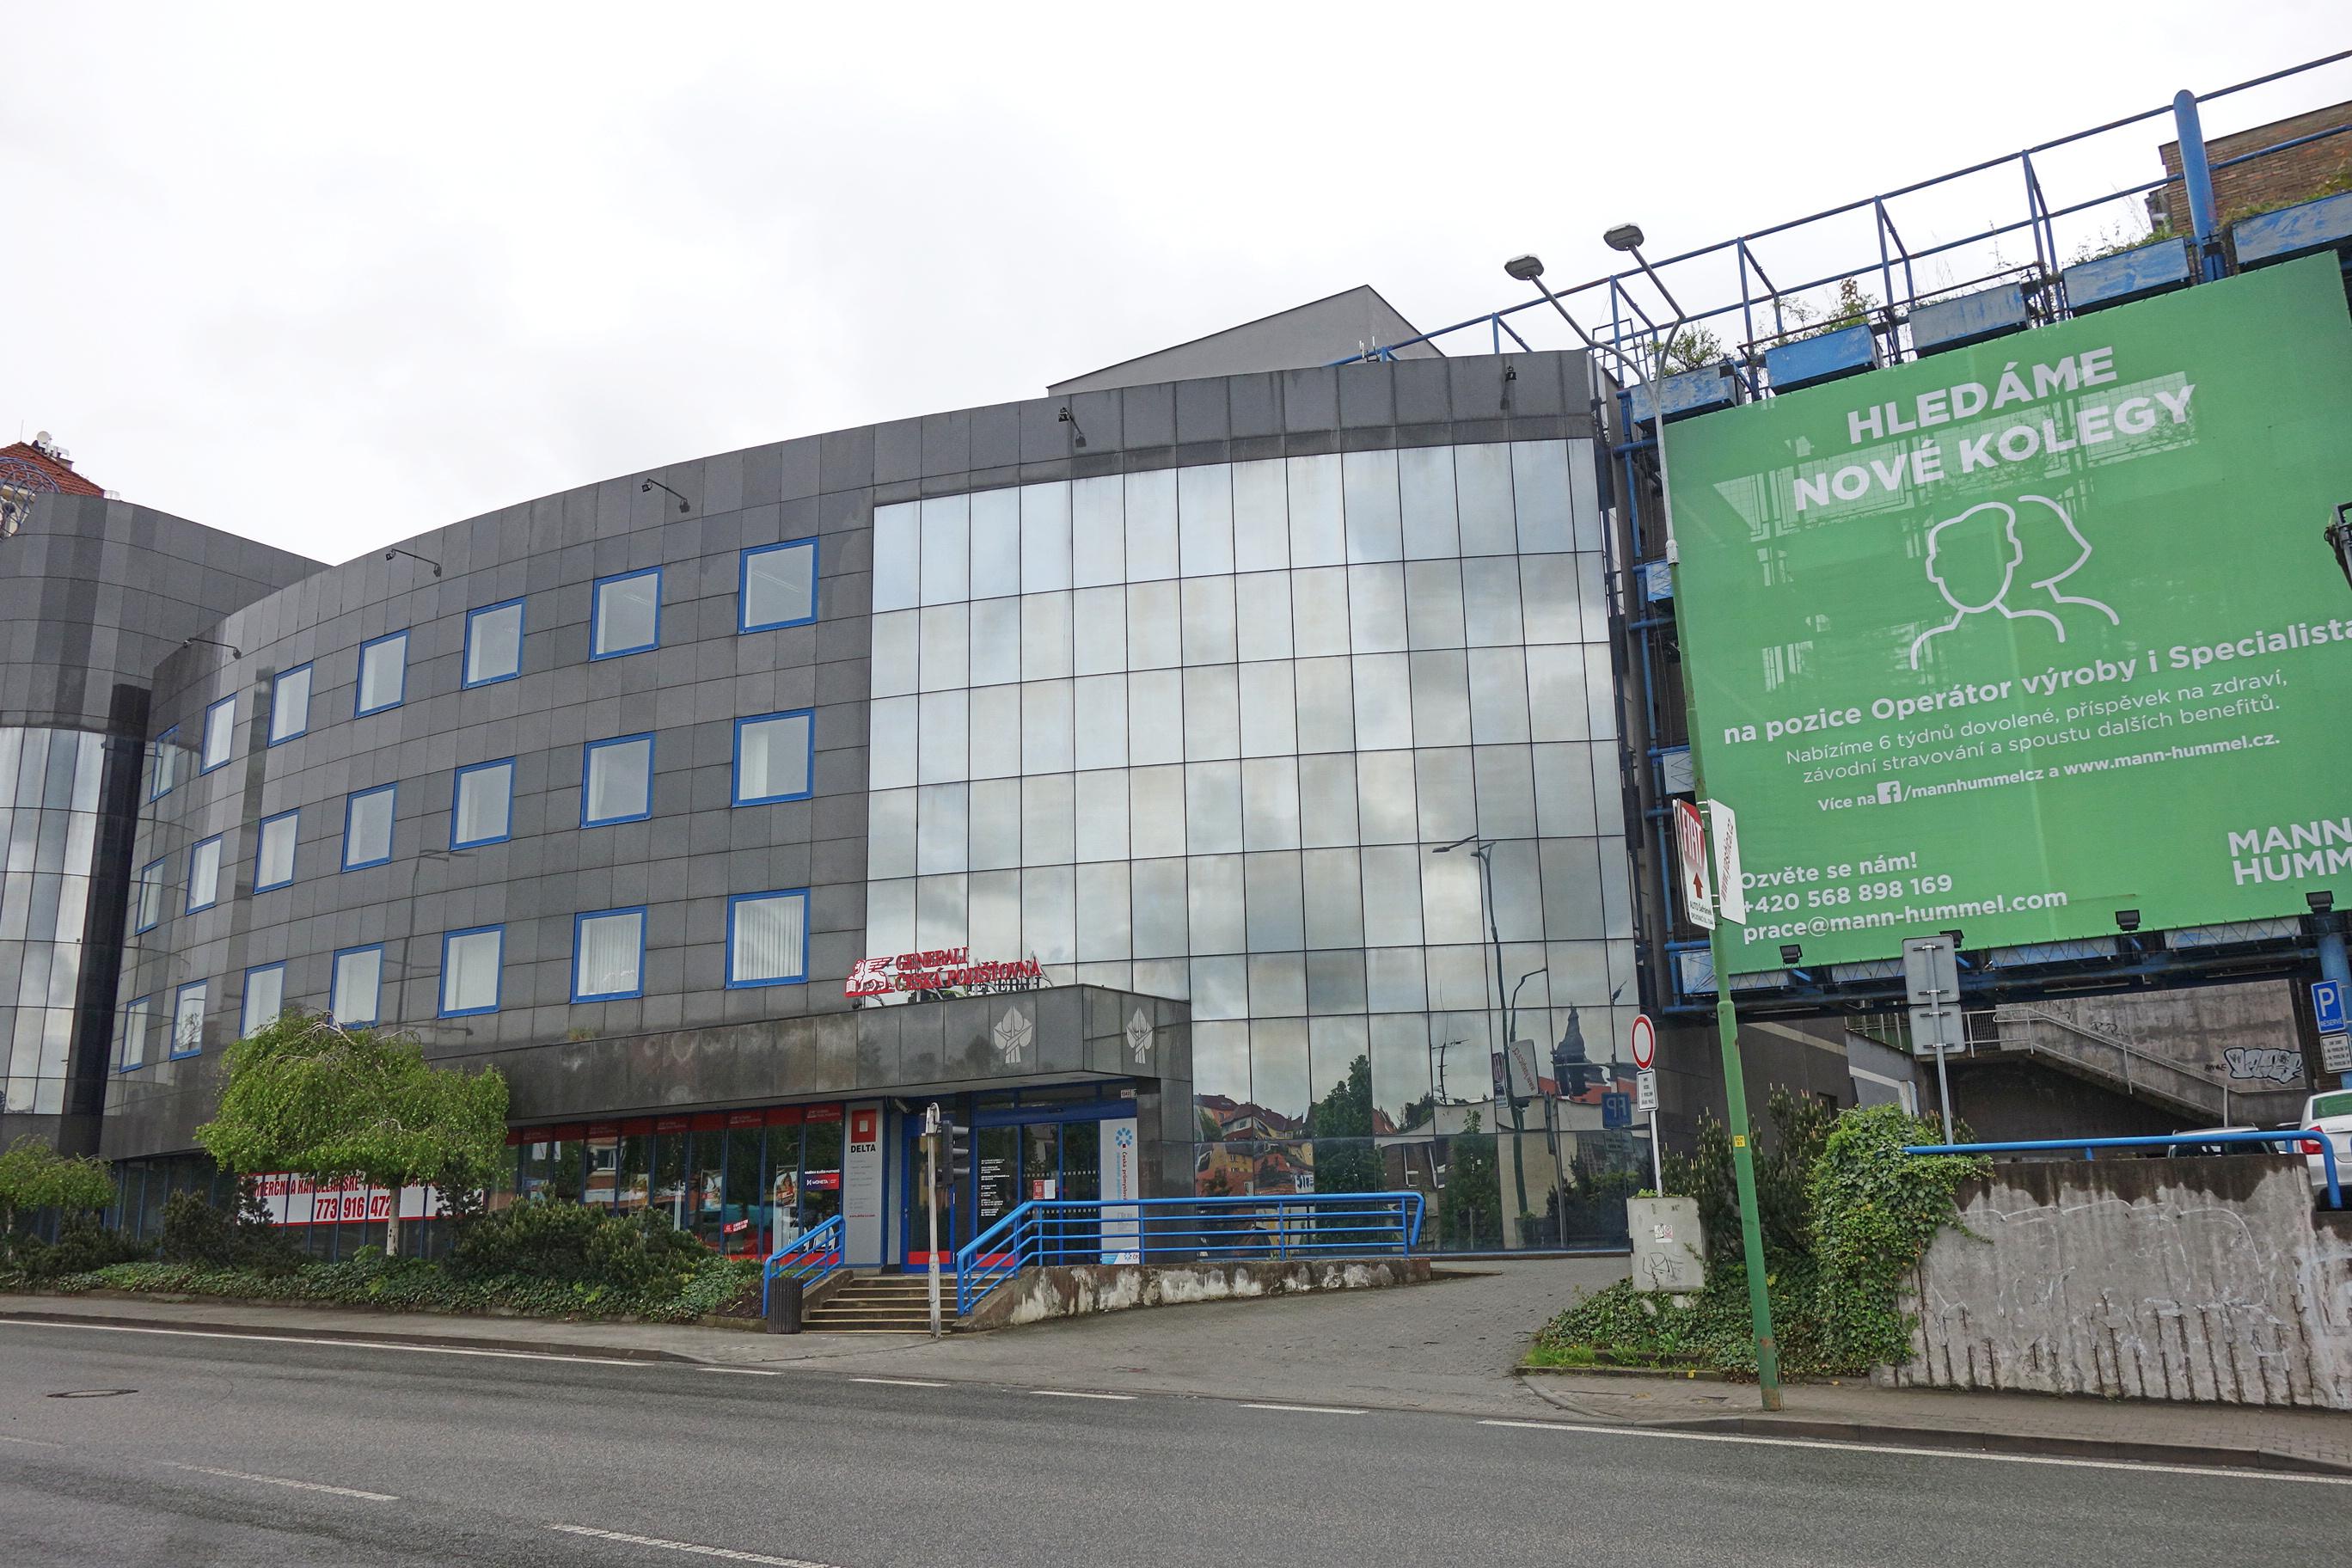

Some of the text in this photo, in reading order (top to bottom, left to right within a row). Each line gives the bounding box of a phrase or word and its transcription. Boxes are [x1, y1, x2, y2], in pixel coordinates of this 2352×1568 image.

[1847, 346, 2117, 444] HLEDÁME
[1794, 384, 2196, 511] NOVÉ KOLEGY
[1724, 725, 1756, 744] na
[1766, 707, 1862, 742] pozice
[1871, 680, 2012, 720] Operátor
[2021, 658, 2136, 695] výroby
[2147, 650, 2159, 673] i
[1786, 669, 2288, 764] Nabízíme 6 týdnů dovolené, příspěvek na zdraví,
[1804, 694, 2281, 783] závodní stravování a spoustu dalších benefitů.
[1817, 796, 1853, 812] Více
[1858, 794, 1876, 806] na
[1903, 769, 2044, 801] /mannhummelcz
[2049, 768, 2060, 778] a
[2064, 733, 2281, 775] www.mann-hummel.cz.
[1681, 806, 1702, 867] FIAT
[2227, 817, 2352, 857] MANN
[1741, 851, 1918, 889] Ozvěte se nám!
[1743, 874, 1953, 914] +420 568 898 169
[1743, 891, 2067, 945] prace@mann-hummel.com
[895, 967, 944, 991] ČESKÁ
[946, 956, 1042, 987] POJIŠŤOVNA
[896, 946, 969, 971] GENERALI
[2318, 988, 2335, 1017] P
[850, 1144, 876, 1153] DELTA
[316, 1197, 338, 1219] 773
[344, 1197, 364, 1218] 916
